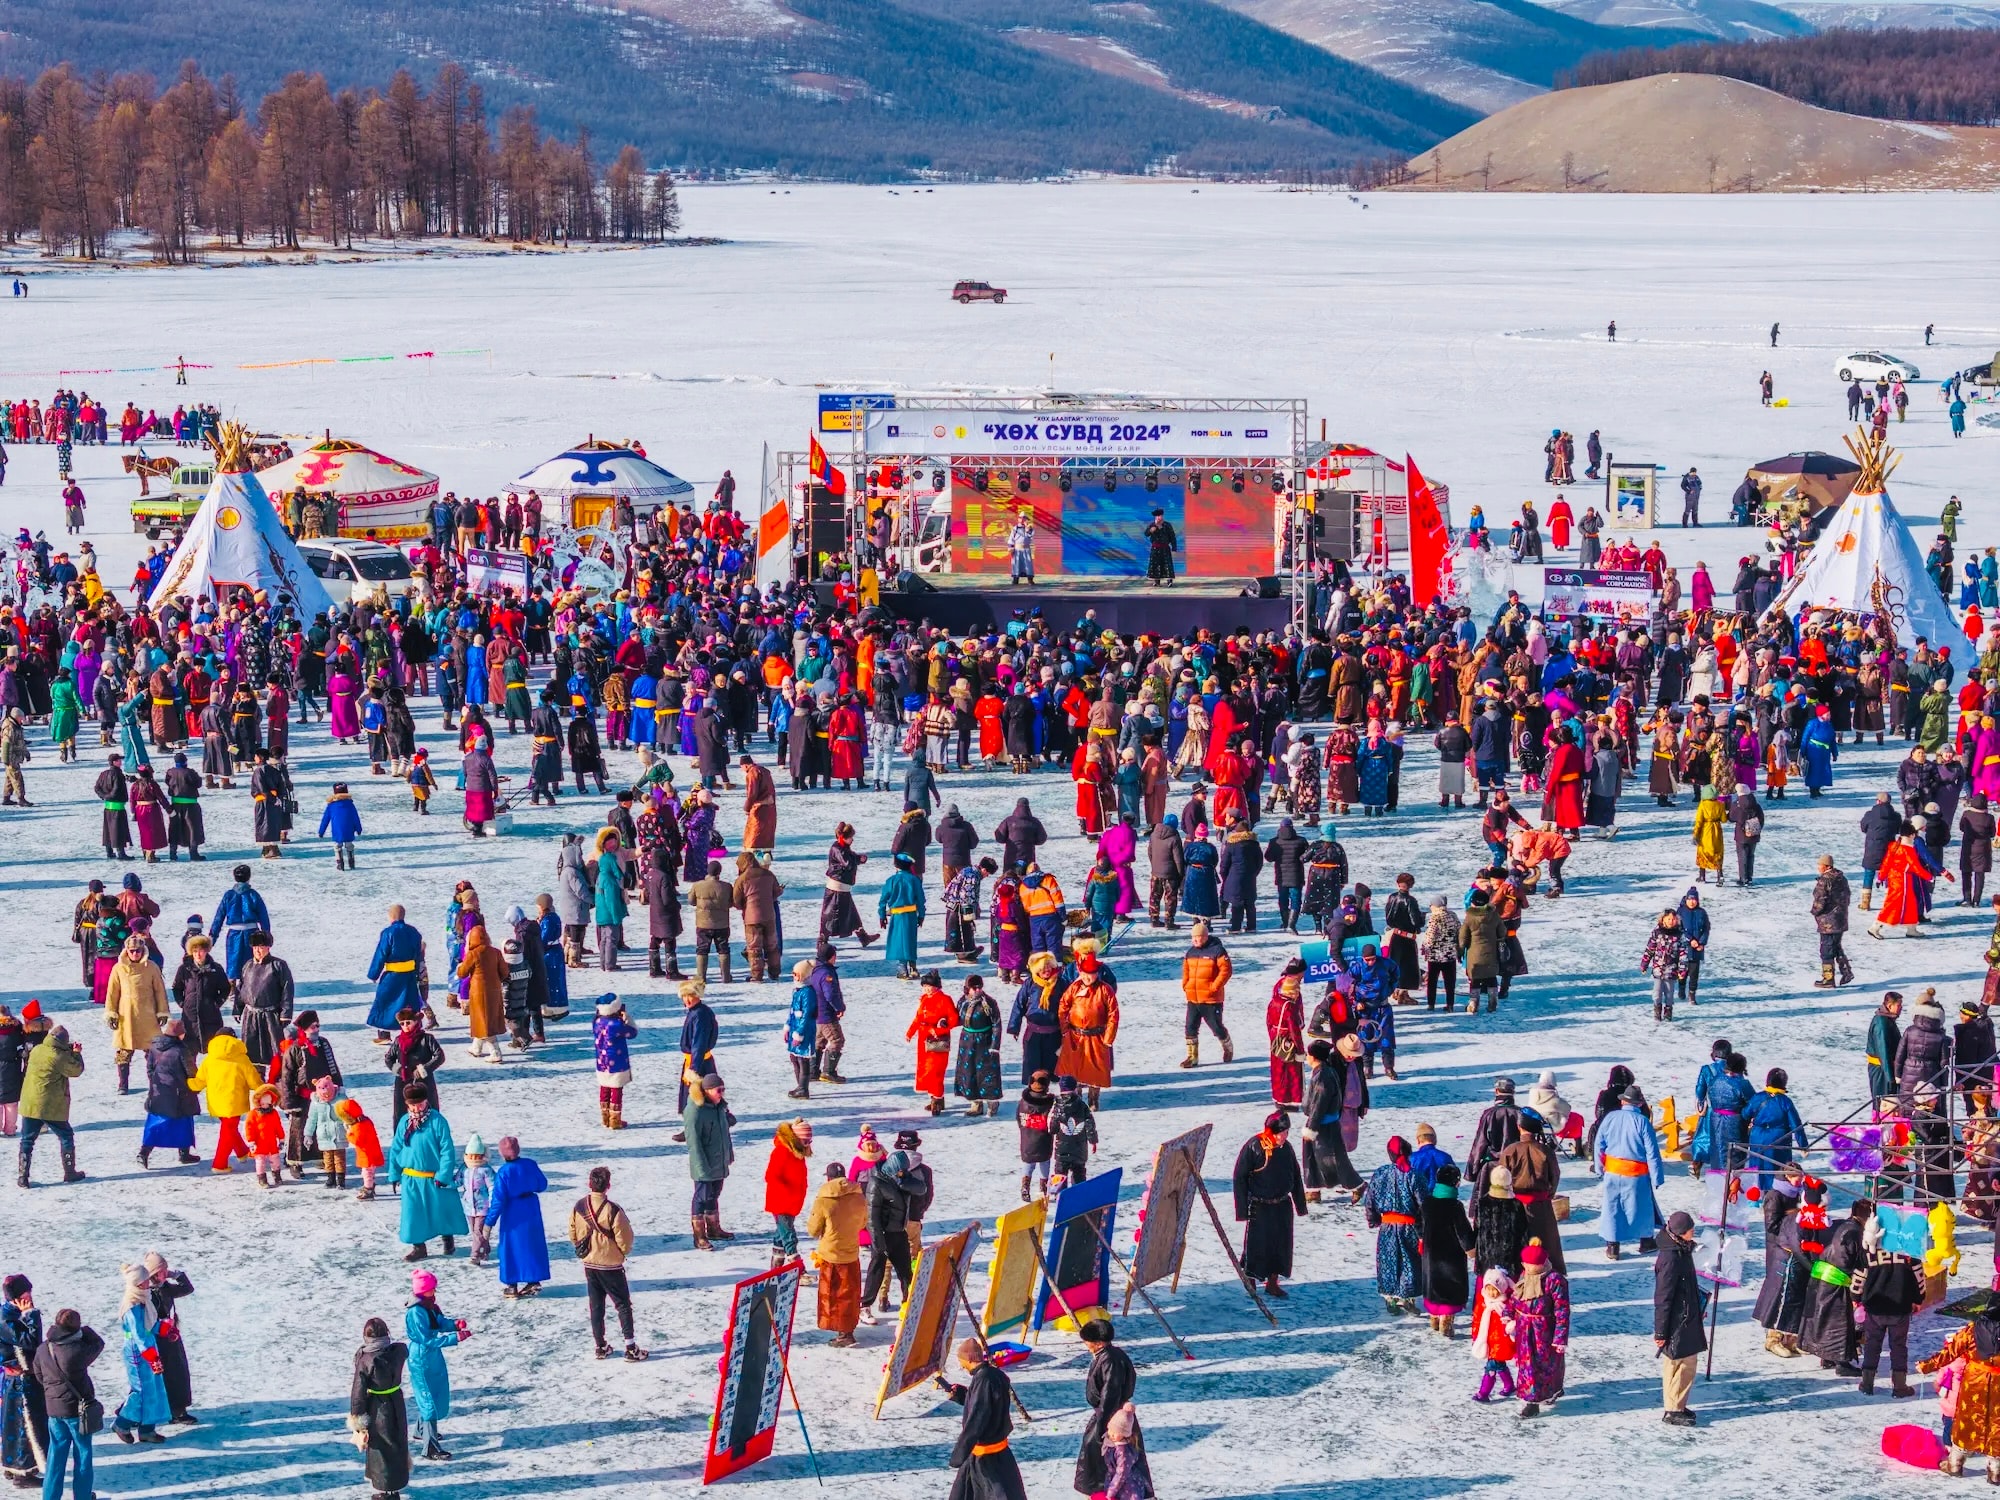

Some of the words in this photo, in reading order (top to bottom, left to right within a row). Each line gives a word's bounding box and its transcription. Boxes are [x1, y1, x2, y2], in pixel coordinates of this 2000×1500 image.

[1046, 424, 1103, 444] СУВД
[1110, 424, 1171, 441] 2024”
[1076, 444, 1113, 452] МӨСНИЙ
